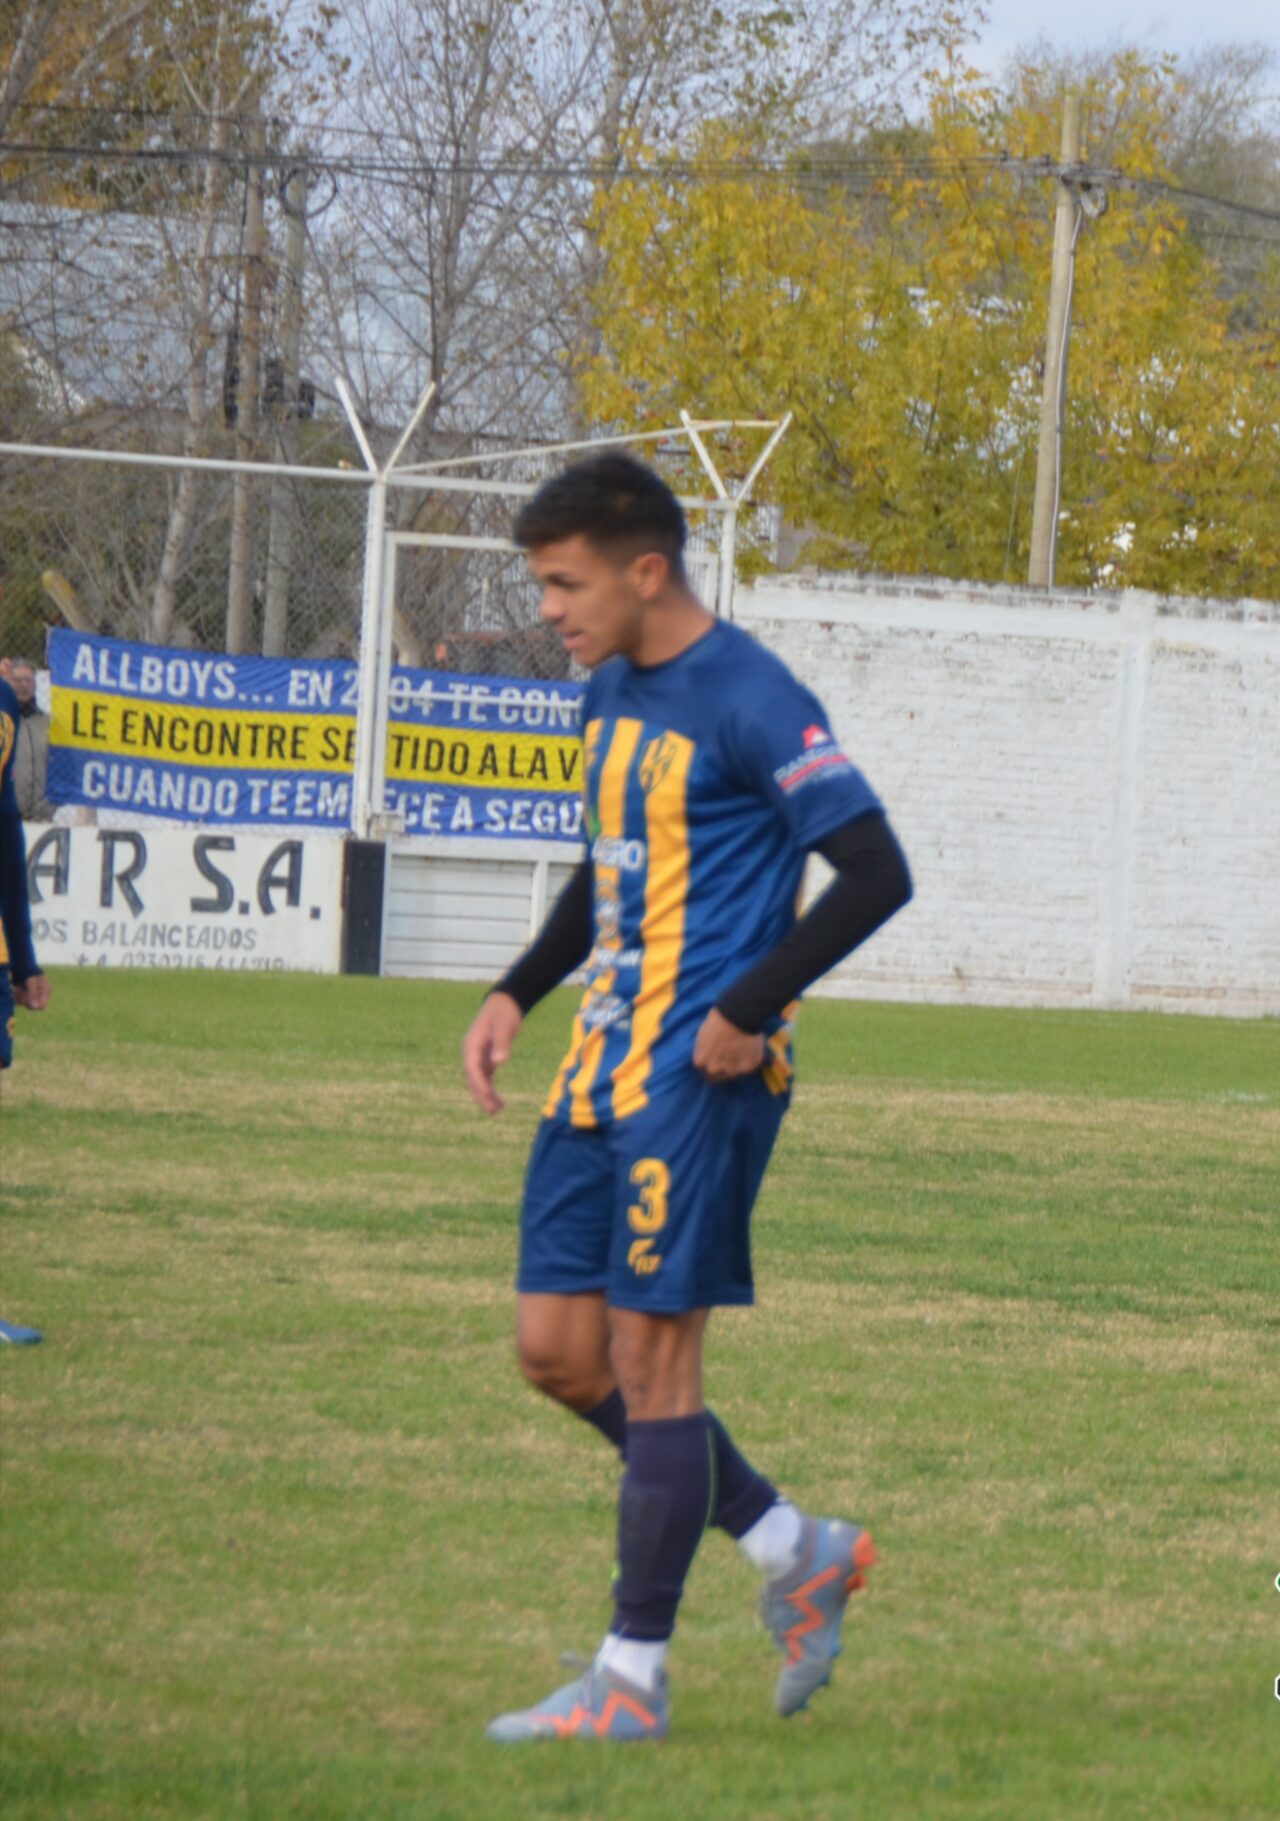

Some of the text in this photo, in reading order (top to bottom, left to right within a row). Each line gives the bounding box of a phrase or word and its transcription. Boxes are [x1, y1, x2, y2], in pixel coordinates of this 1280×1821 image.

[288, 669, 333, 706] EN
[340, 672, 434, 717] 204
[449, 683, 490, 722] TE
[71, 701, 108, 740] LE
[121, 709, 310, 760] ENCONTRE
[320, 726, 470, 777] SETIDO
[478, 744, 499, 777] A
[508, 745, 549, 781] LA
[82, 761, 238, 816] CUANDO
[450, 796, 474, 831] A
[190, 834, 321, 920] S.A.
[82, 921, 258, 950] BALANCEADOS
[627, 1157, 671, 1234] 3
